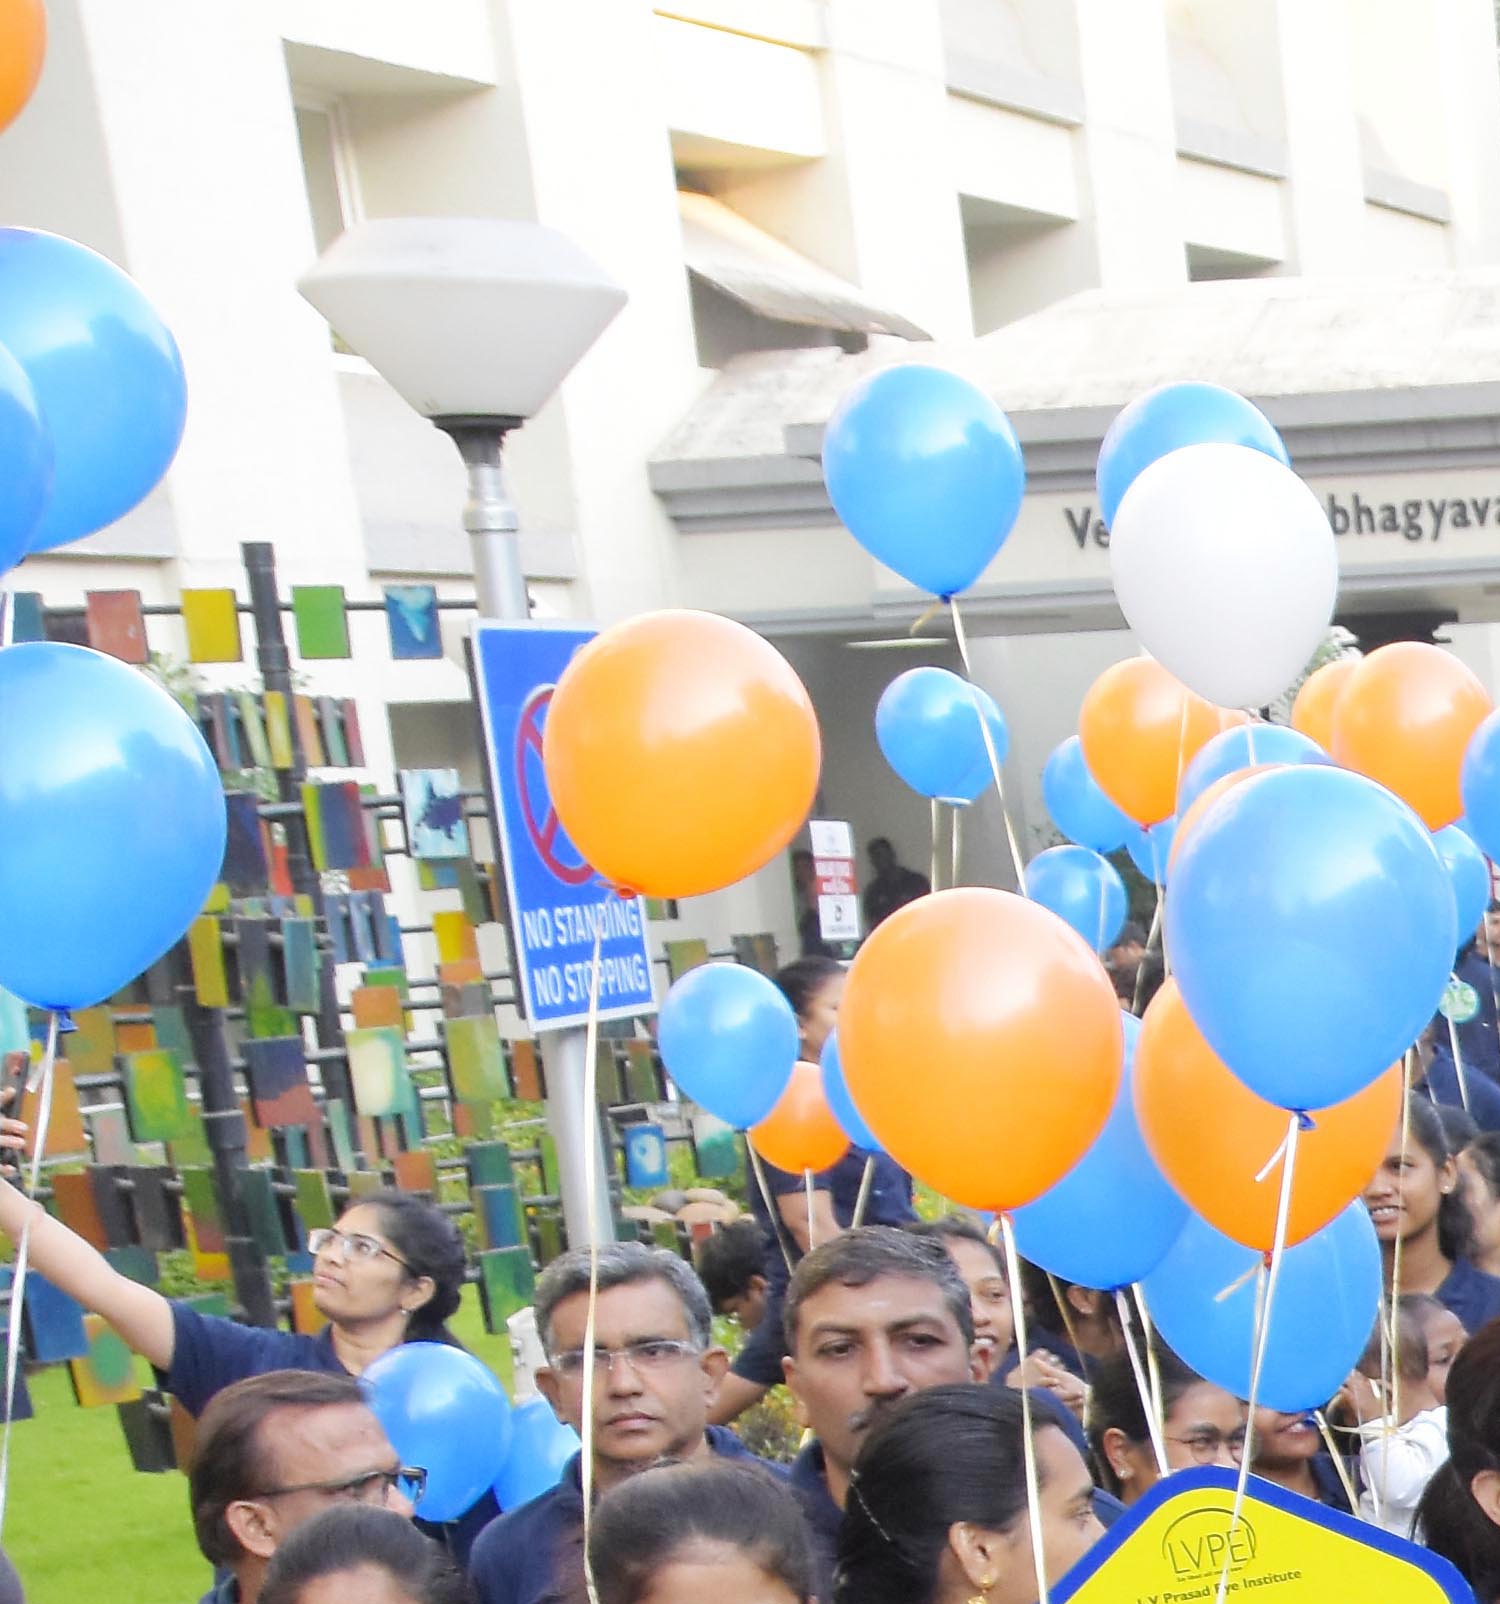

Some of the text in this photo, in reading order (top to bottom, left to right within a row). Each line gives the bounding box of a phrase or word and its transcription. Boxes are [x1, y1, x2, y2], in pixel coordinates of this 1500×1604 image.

[522, 900, 641, 949] NO STANDING
[534, 965, 562, 1006] NO
[1168, 1528, 1255, 1574] LVPEI
[1163, 1586, 1211, 1604] Prasad
[1243, 1570, 1302, 1589] Institute
